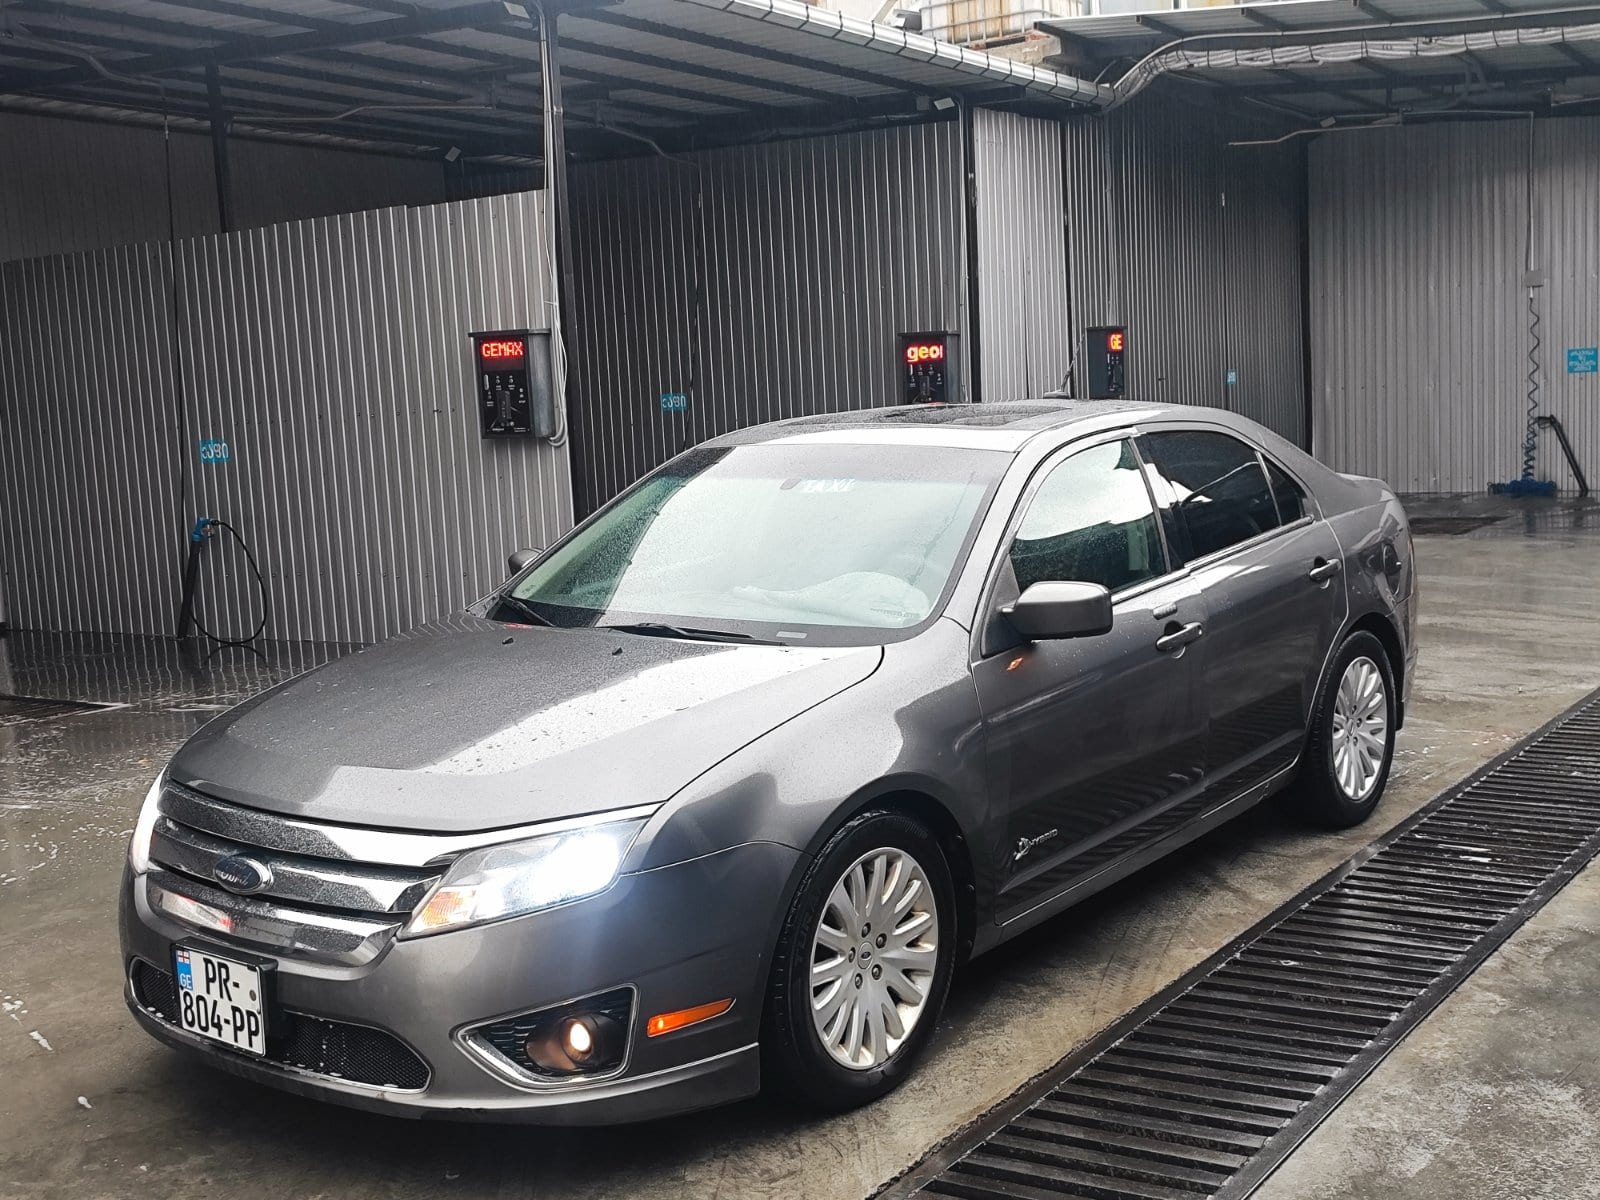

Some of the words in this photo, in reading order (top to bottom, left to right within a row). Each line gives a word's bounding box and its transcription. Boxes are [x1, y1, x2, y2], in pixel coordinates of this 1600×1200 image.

[482, 341, 523, 357] GEMAX
[180, 973, 193, 990] GE
[183, 991, 260, 1048] 804-PP
